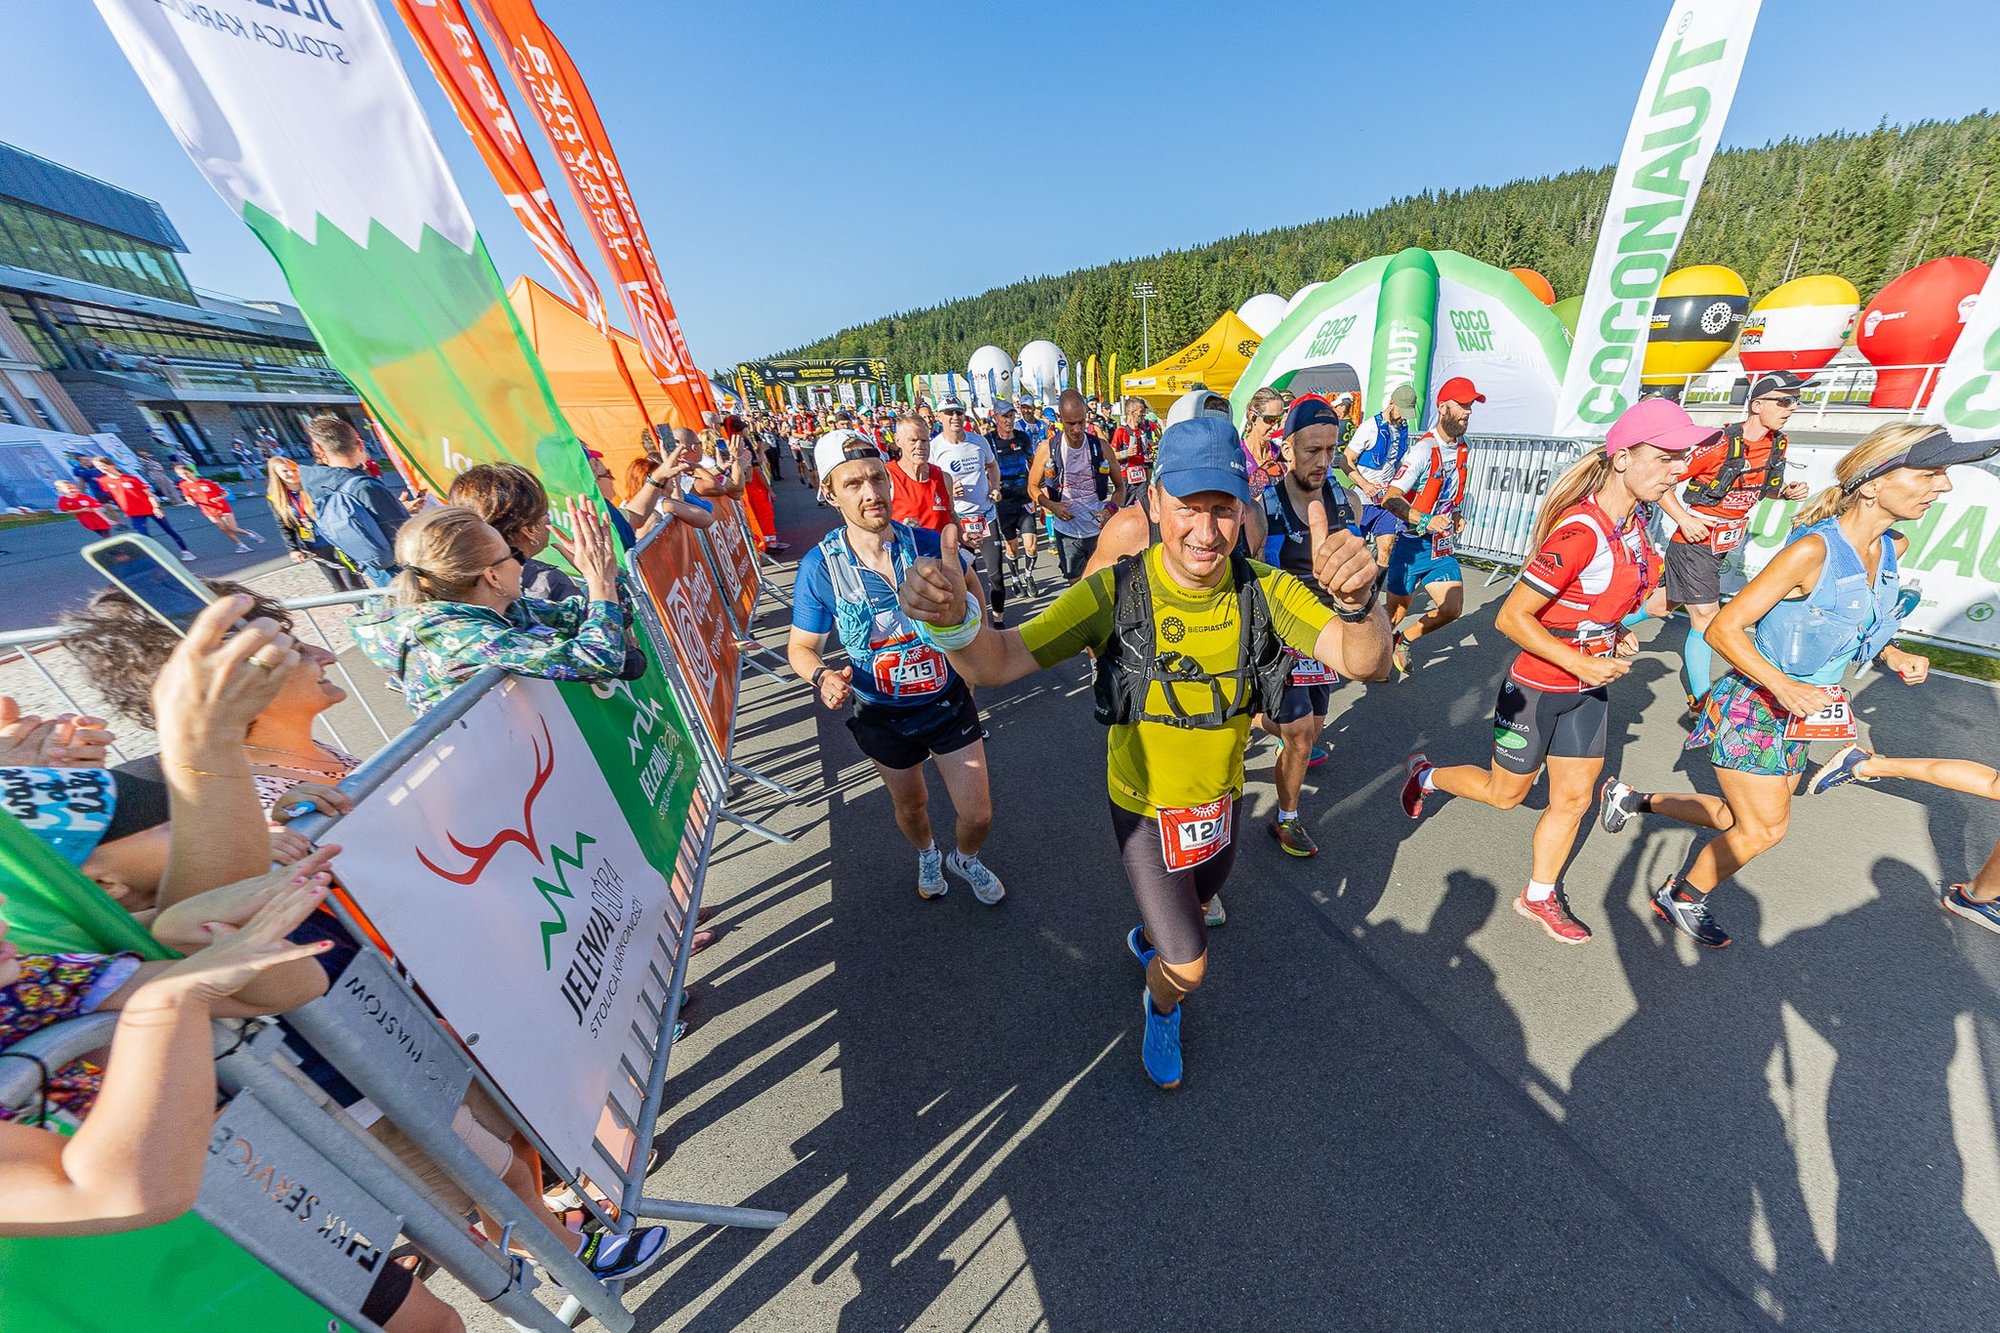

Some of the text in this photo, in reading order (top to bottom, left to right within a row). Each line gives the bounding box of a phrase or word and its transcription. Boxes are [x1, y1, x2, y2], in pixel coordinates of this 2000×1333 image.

[1577, 38, 1727, 425] COCONAUT
[1317, 315, 1357, 338] COCO
[1450, 310, 1489, 331] COCO
[1305, 335, 1346, 359] NAUT
[1456, 330, 1494, 351] NAUT
[1723, 530, 1738, 541] 21
[894, 661, 932, 681] 215
[1186, 816, 1223, 842] 127
[561, 858, 624, 1027] JELENIA GÓRA
[590, 895, 643, 1040] STOLICA KARKONOSZY
[345, 976, 424, 1063] PIASTÓW
[208, 1126, 320, 1223] SERVICE
